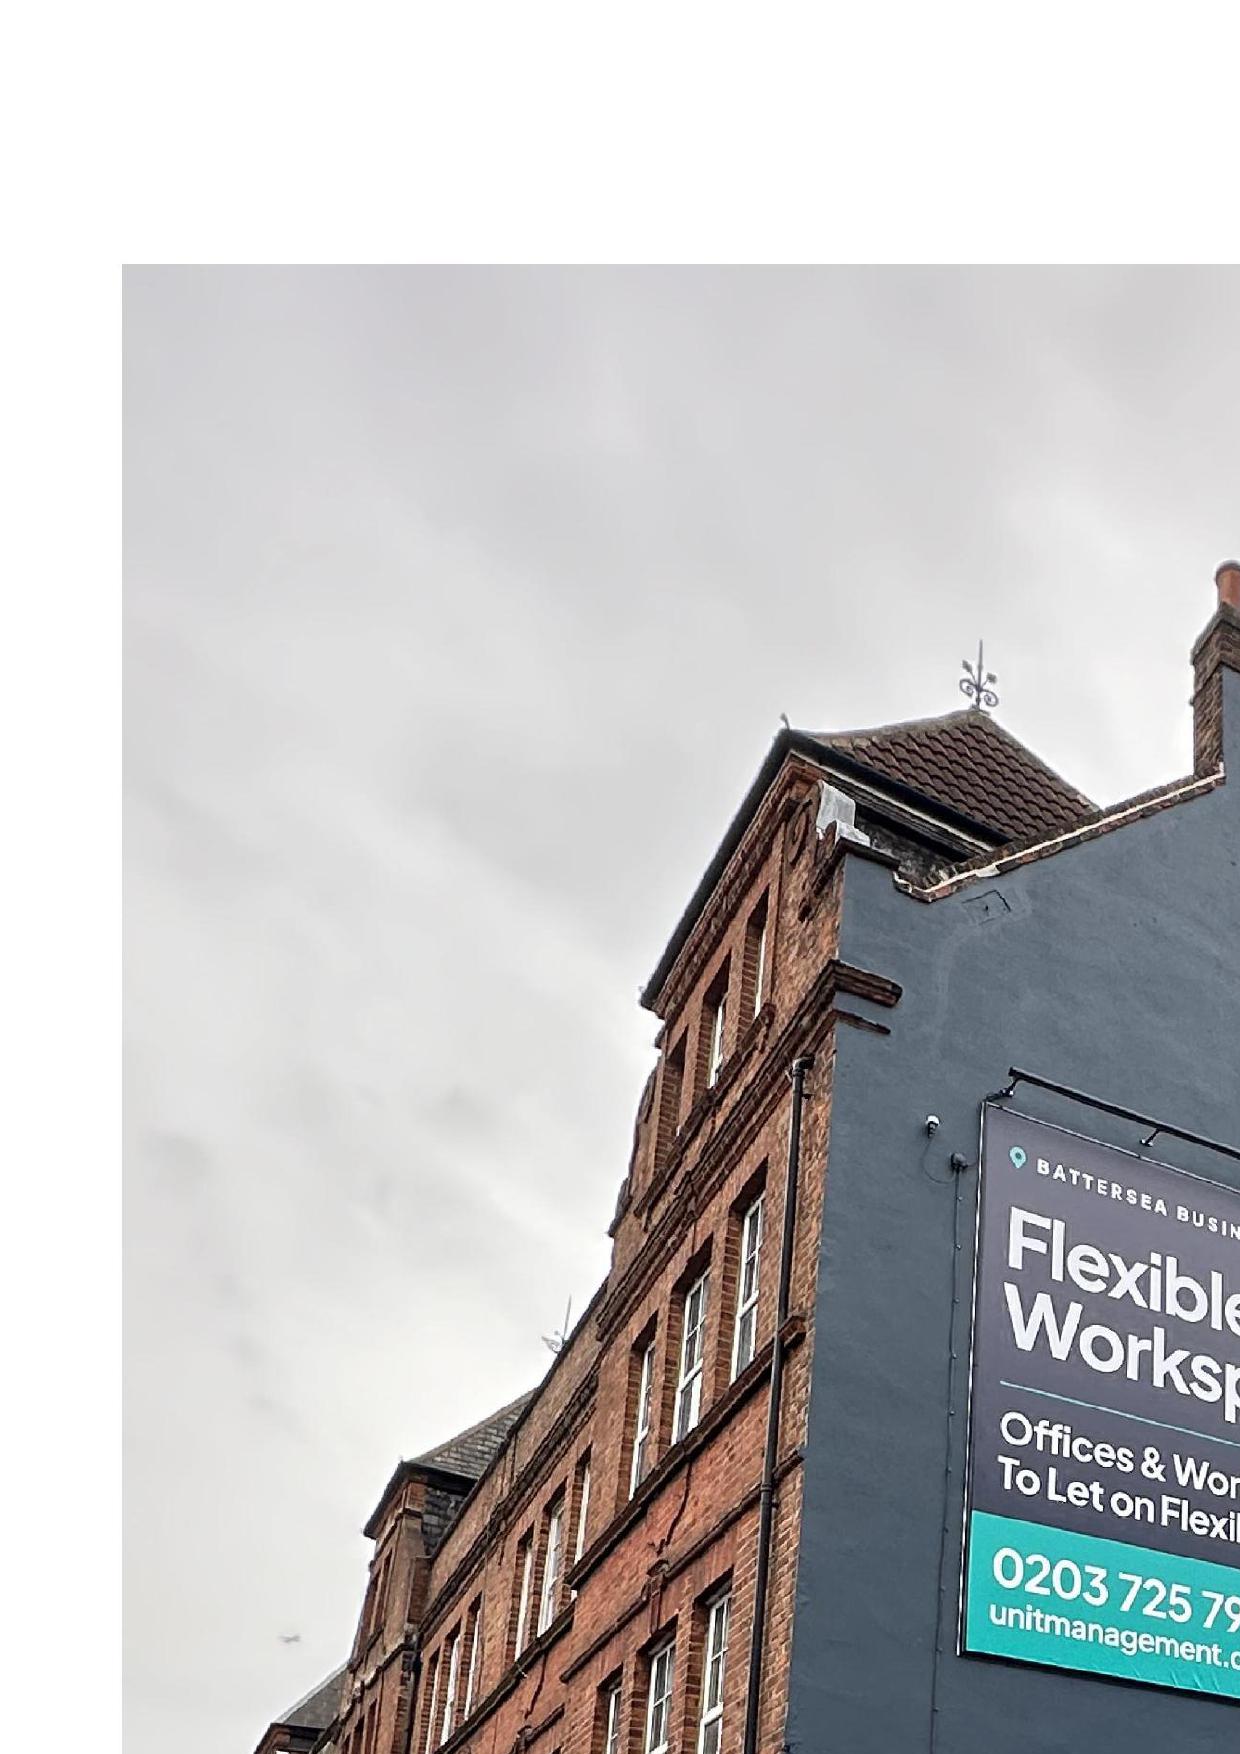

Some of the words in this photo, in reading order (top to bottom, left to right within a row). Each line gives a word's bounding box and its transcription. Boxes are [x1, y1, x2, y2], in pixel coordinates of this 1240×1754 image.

[1037, 1158, 1168, 1217] BATTERSEA
[1000, 1412, 1134, 1473] Offices
[1140, 1447, 1167, 1482] &
[997, 1455, 1041, 1496] To
[1047, 1467, 1104, 1512] Let
[1110, 1493, 1156, 1523] on
[992, 1547, 1109, 1613] 0203
[1118, 1573, 1193, 1623] 725
